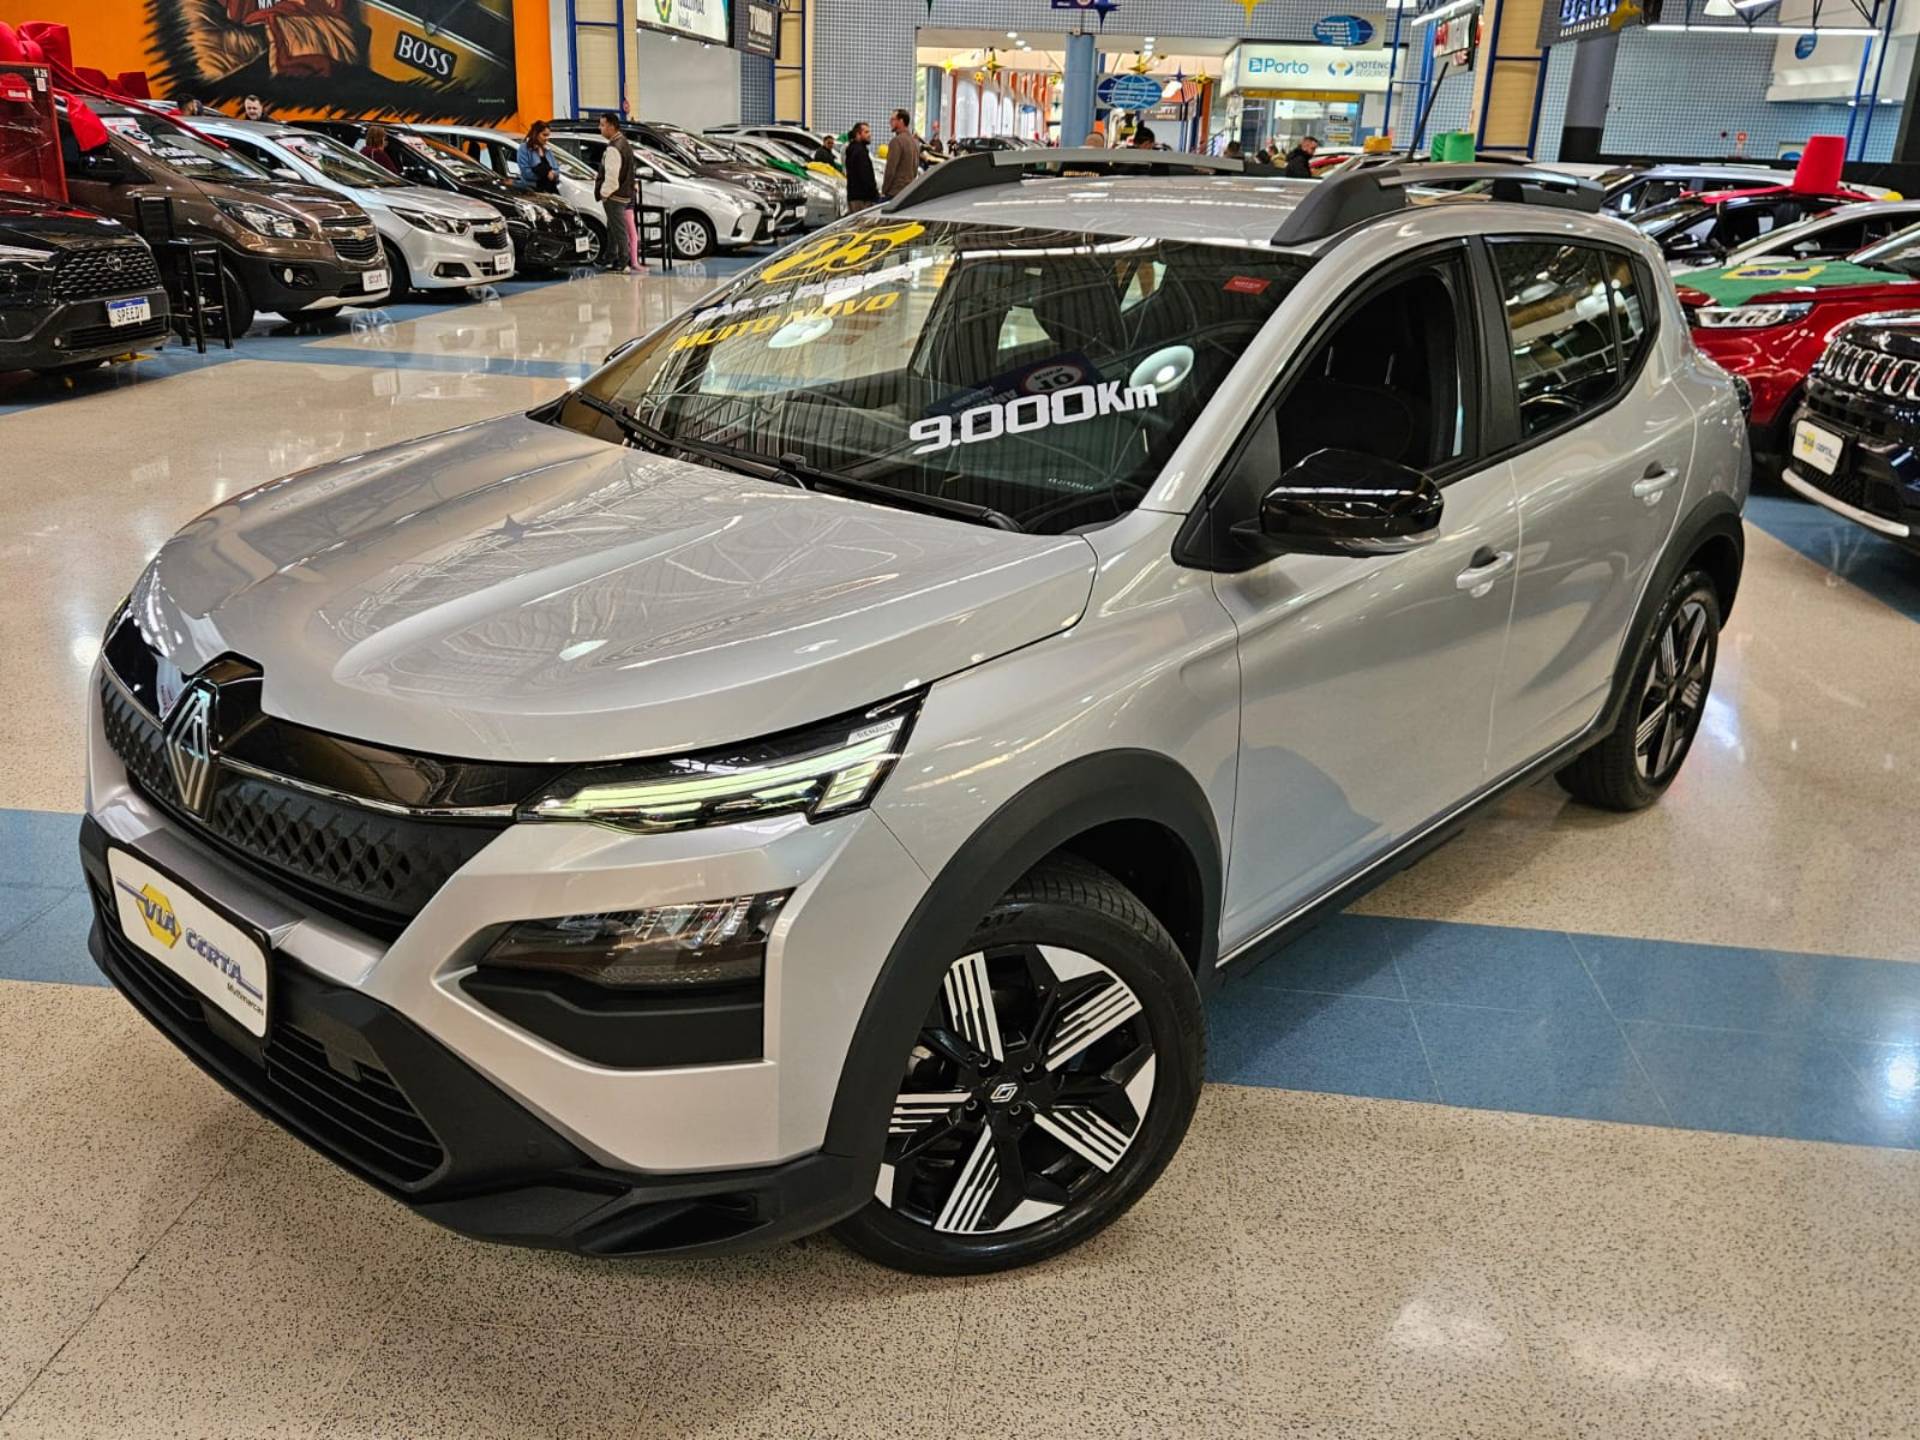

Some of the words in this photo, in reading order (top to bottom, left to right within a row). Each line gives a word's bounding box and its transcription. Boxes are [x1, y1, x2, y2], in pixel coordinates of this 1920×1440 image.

[398, 34, 452, 75] BOSS
[1264, 57, 1309, 74] Porto
[760, 221, 926, 283] 25
[668, 315, 781, 352] MUITO
[778, 292, 900, 327] NOVO
[909, 380, 1158, 455] 9.000Km
[143, 898, 177, 937] VIA
[186, 927, 243, 983] CERTA
